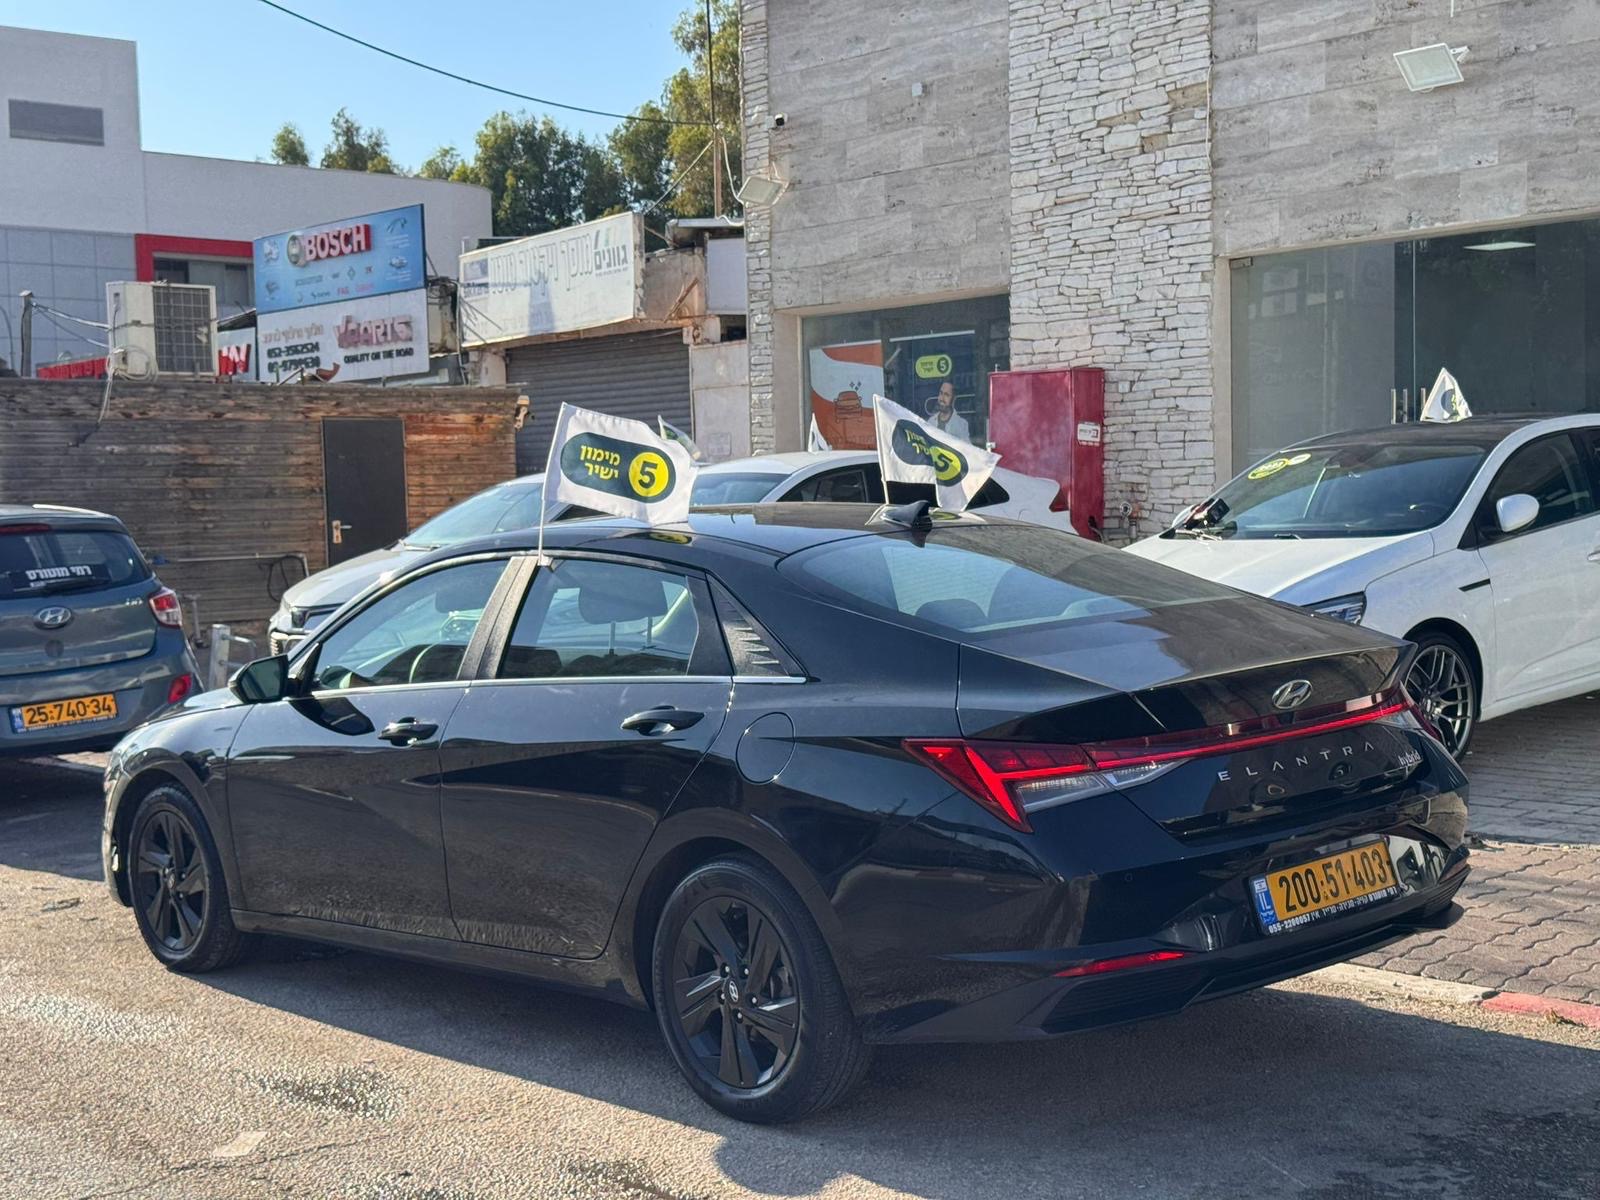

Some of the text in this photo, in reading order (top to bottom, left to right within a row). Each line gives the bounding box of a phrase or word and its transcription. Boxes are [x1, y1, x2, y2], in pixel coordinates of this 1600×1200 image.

[305, 224, 371, 261] BOSCH
[594, 244, 629, 270] גוונים
[939, 359, 947, 371] 5
[579, 444, 621, 467] מימון
[934, 453, 954, 473] 5
[584, 462, 619, 480] ישיר
[638, 460, 658, 490] 5
[25, 565, 92, 580] רמי מוטורס
[1217, 741, 1375, 782] ELANTRA
[1259, 893, 1271, 911] IL
